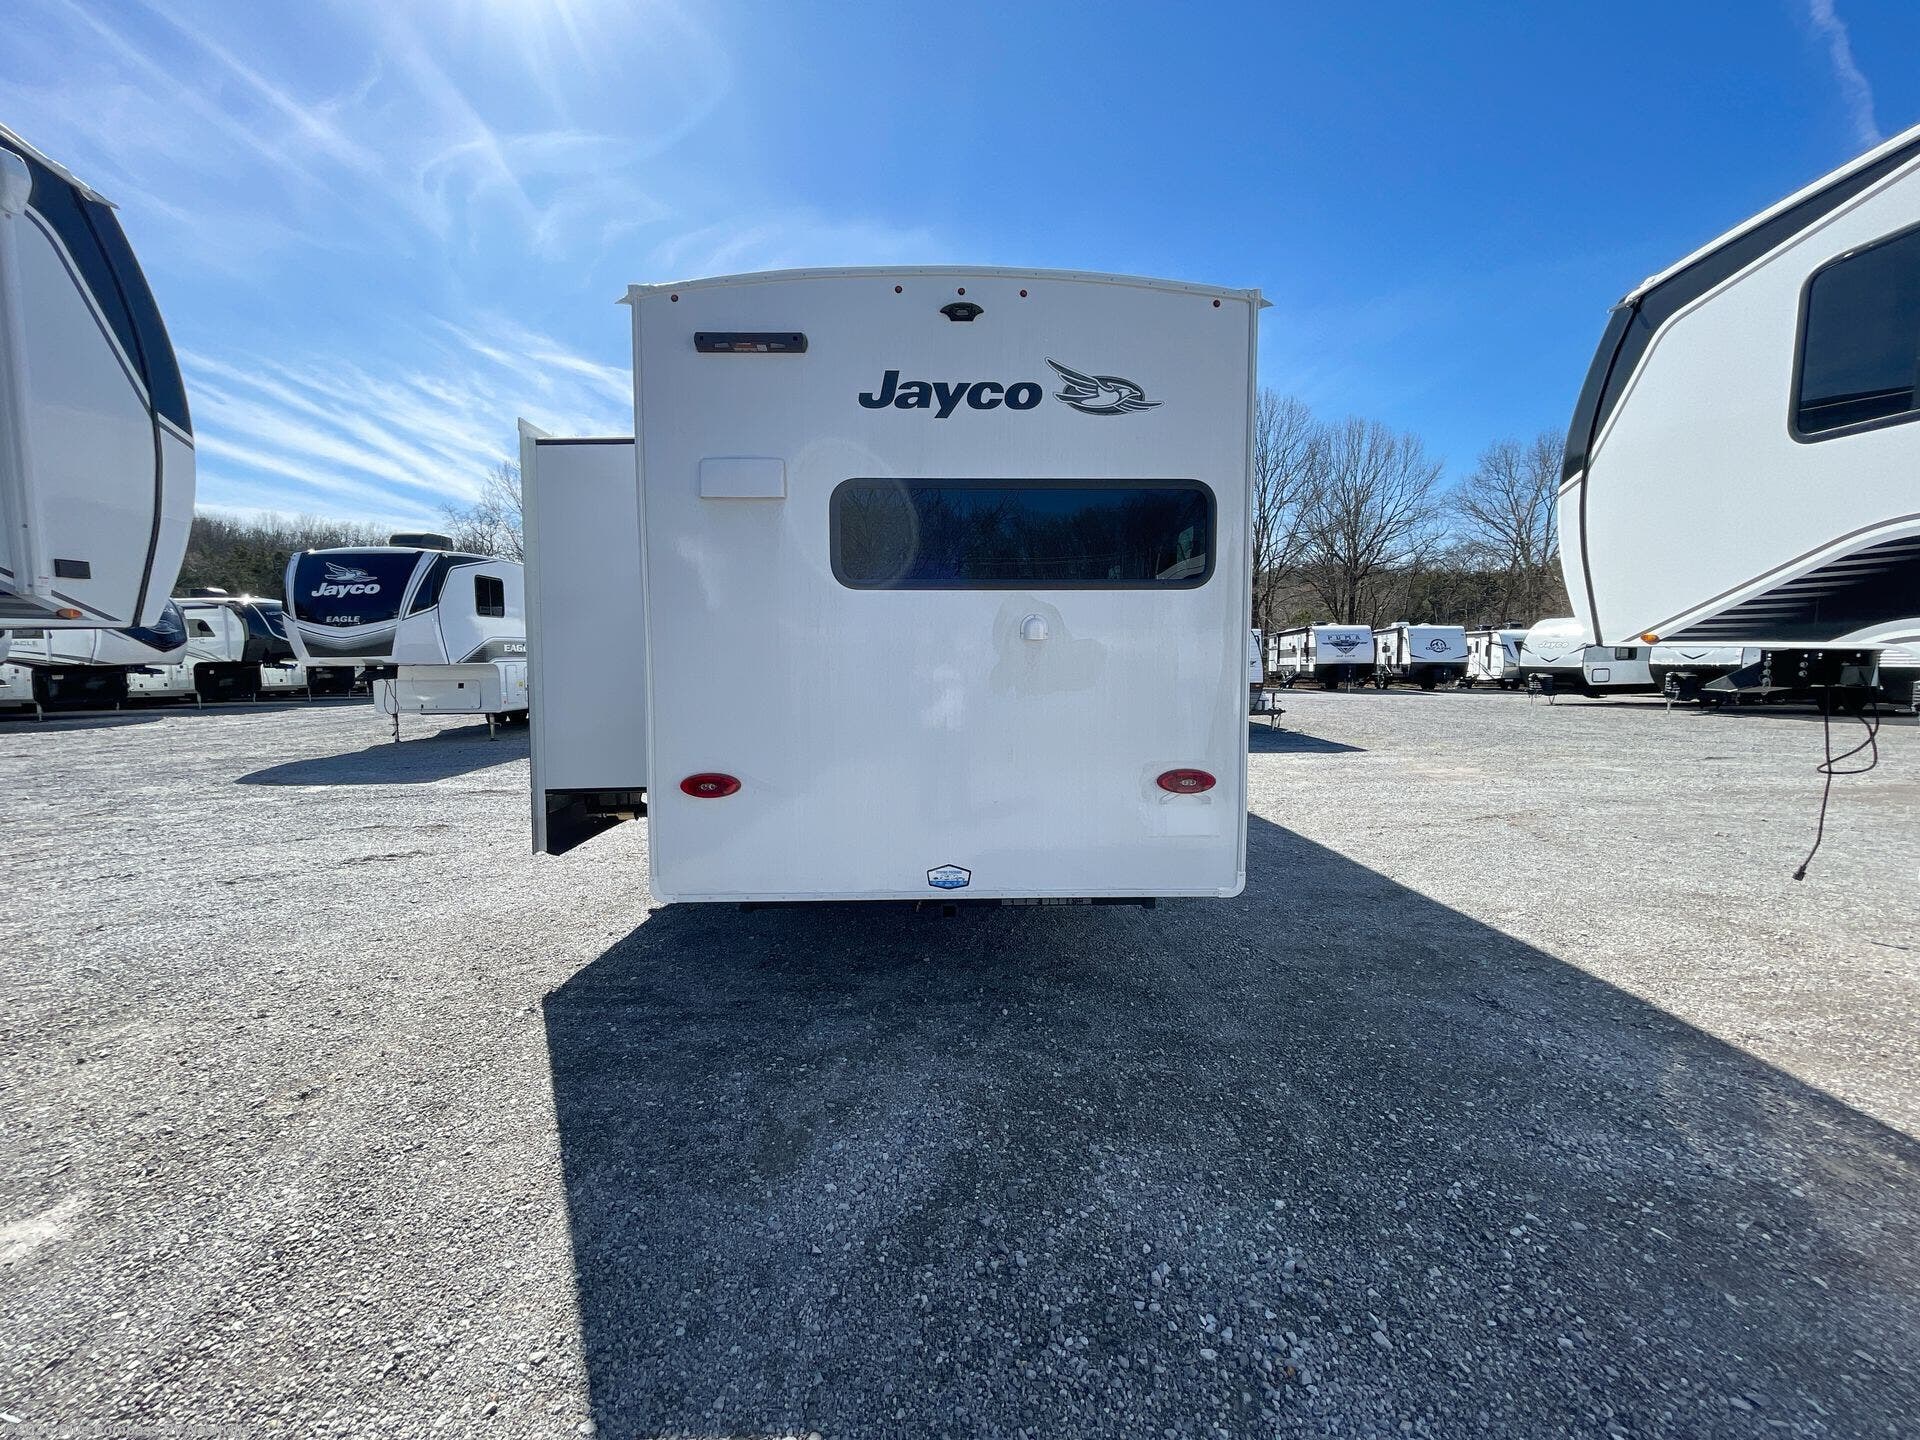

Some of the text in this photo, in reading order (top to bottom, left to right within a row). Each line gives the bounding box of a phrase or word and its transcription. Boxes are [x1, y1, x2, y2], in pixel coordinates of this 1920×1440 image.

[858, 370, 1043, 419] Jayco
[311, 582, 381, 598] Jayco
[326, 615, 361, 623] EAGLE
